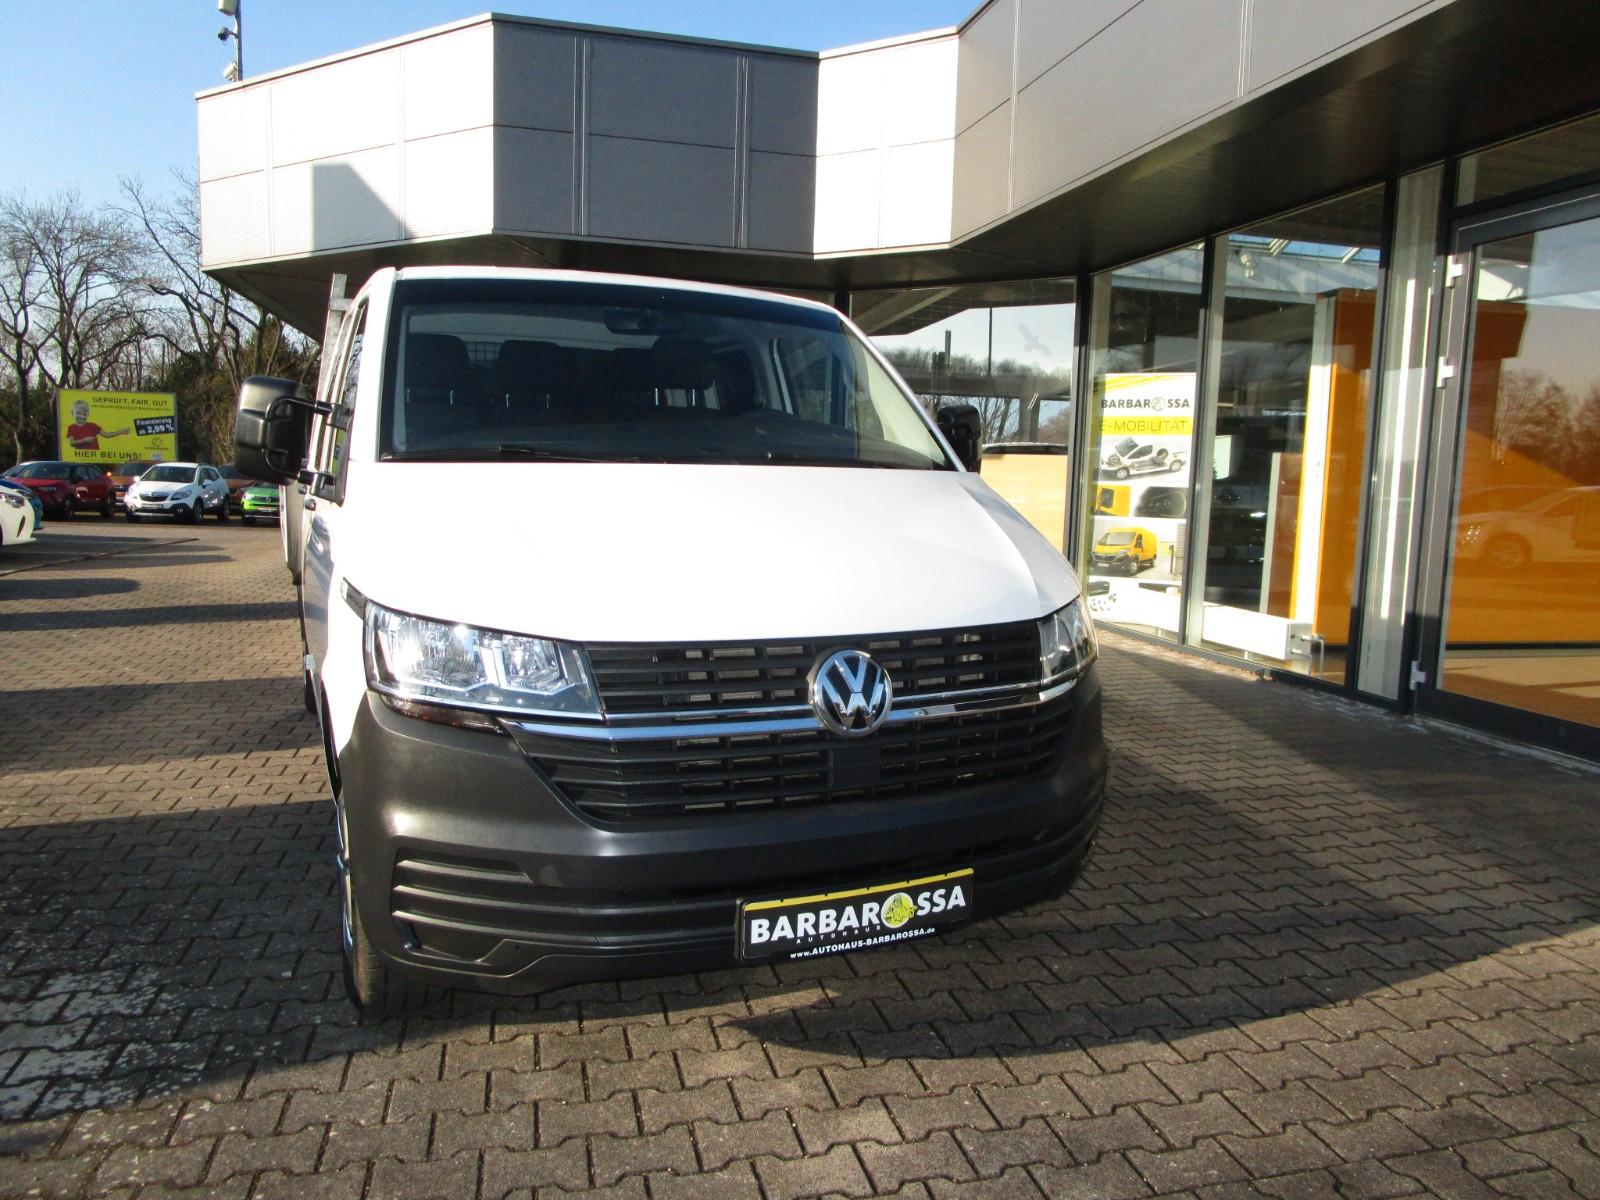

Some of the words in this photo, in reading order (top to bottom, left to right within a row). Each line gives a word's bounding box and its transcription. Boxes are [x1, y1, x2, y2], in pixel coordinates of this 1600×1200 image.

[74, 450, 97, 458] HIER
[101, 451, 116, 459] BEI
[119, 452, 142, 460] UNS!
[751, 885, 967, 944] BARBAROSSA
[790, 927, 935, 959] www.AUTOHAUS-BARBAROSSA.de
